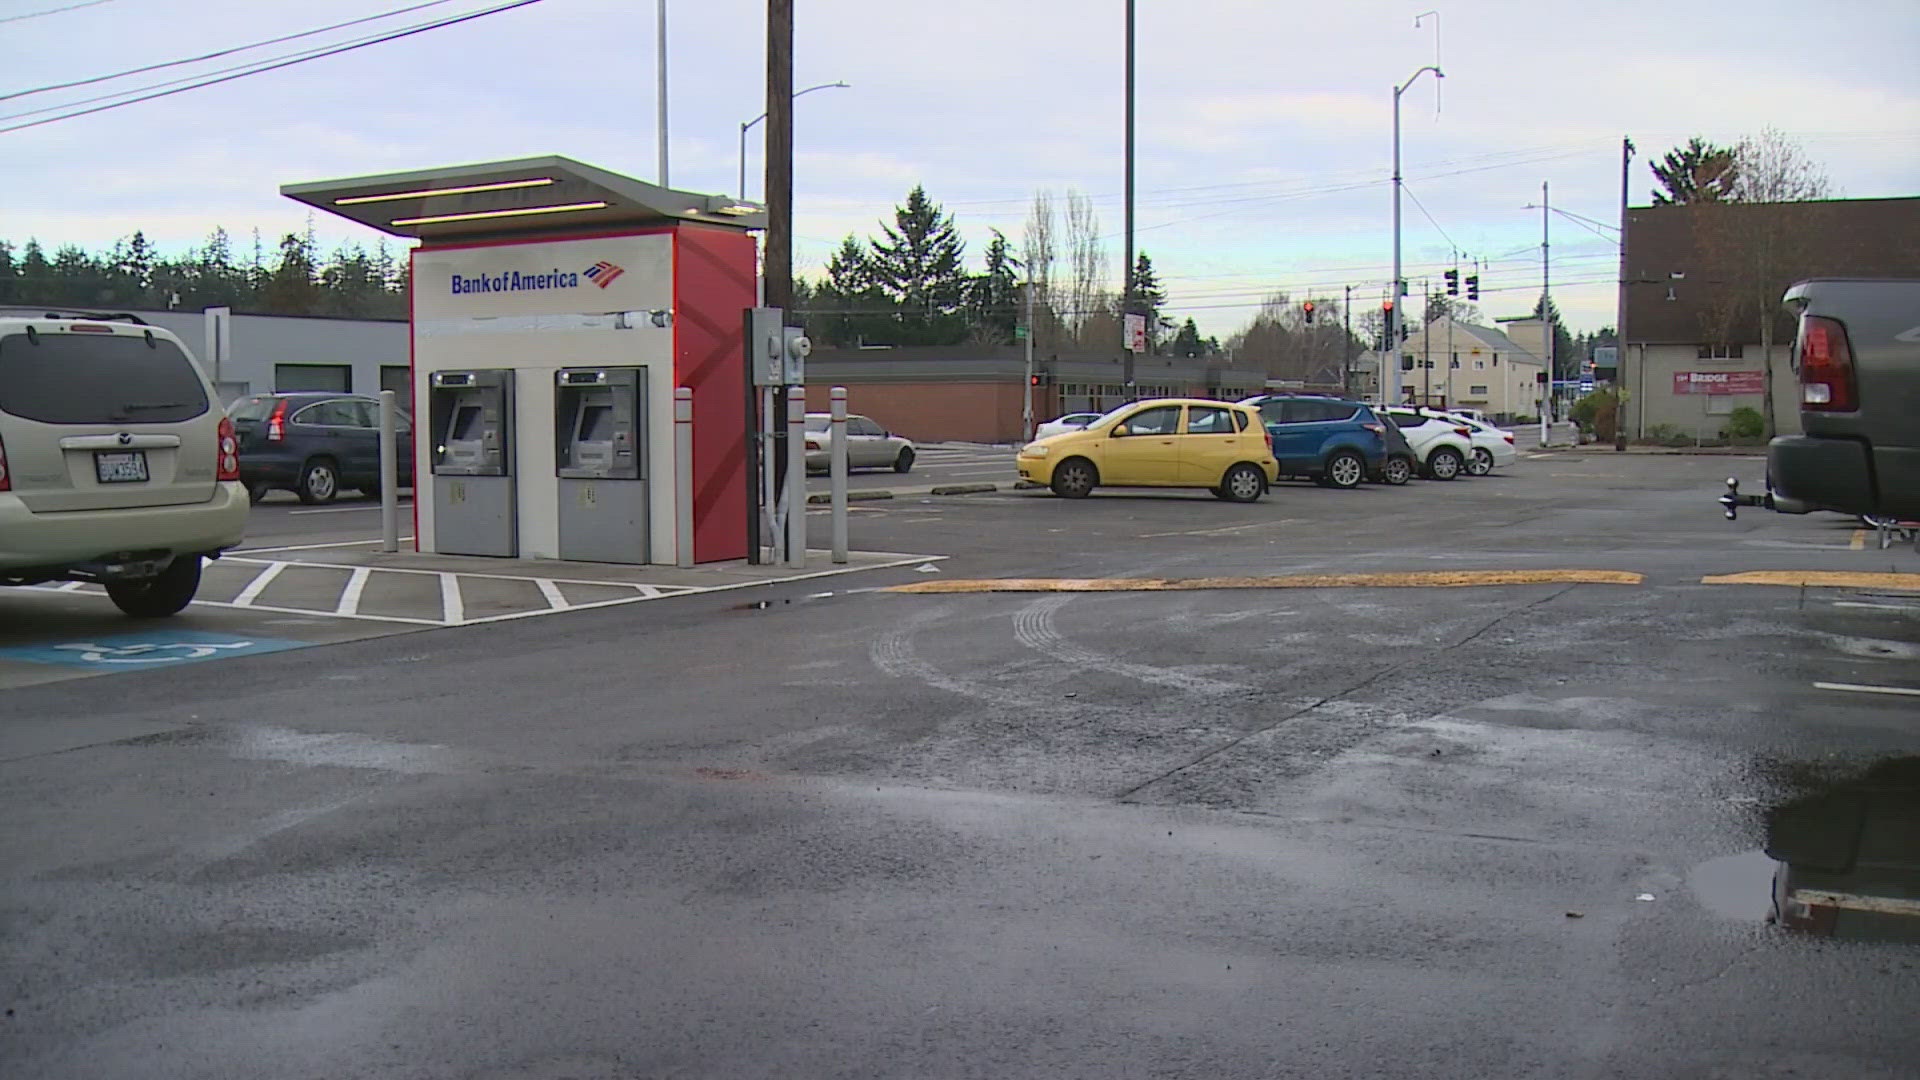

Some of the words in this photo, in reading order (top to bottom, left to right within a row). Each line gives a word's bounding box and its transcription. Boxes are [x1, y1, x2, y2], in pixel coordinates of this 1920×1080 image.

[452, 272, 491, 294] Bank
[492, 271, 509, 292] of
[510, 268, 578, 291] America
